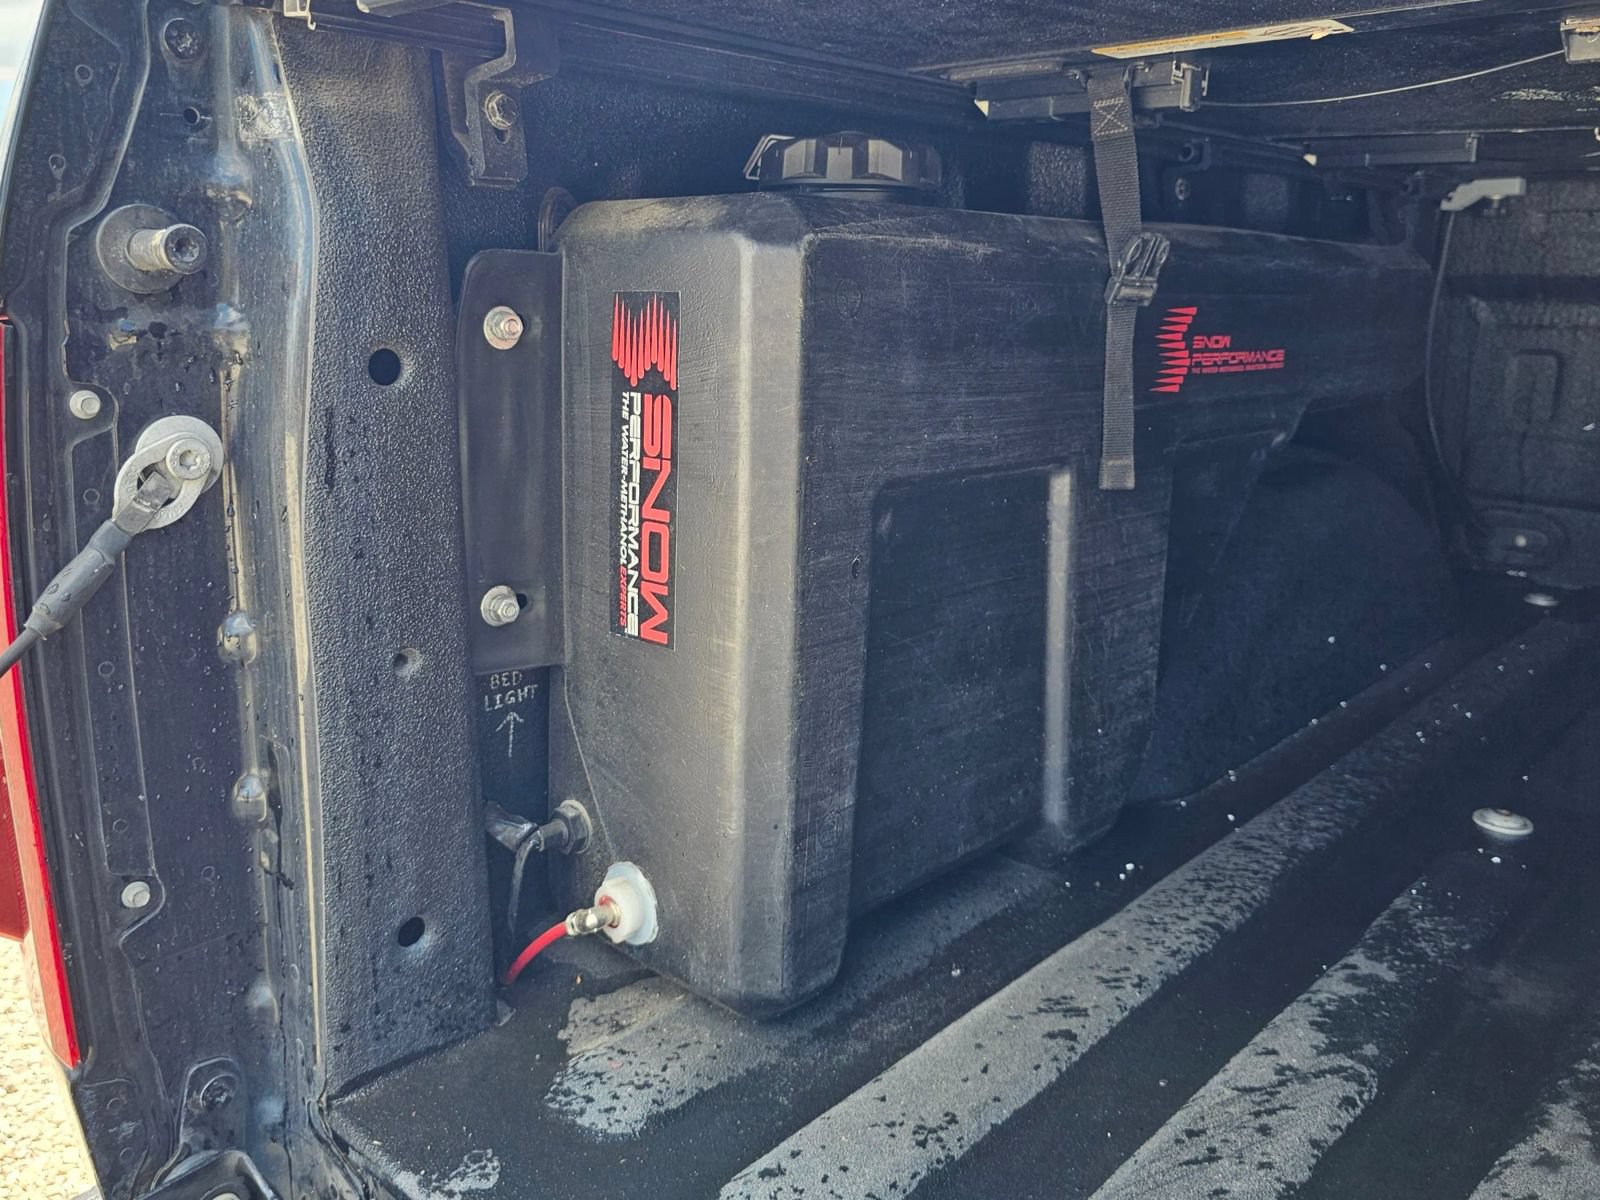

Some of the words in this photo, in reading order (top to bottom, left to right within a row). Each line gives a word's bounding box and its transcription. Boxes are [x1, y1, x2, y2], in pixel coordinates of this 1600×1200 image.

[1193, 336, 1231, 348] SNOW
[1192, 349, 1285, 366] PERFORMANCE
[622, 391, 630, 420] THE
[620, 425, 630, 565] WATER-METHANOL
[627, 391, 642, 637] PERFORMANCE
[641, 393, 672, 645] SNOW
[619, 565, 628, 627] EXPERTS
[490, 671, 522, 689] BED
[484, 684, 538, 711] LIGHT
